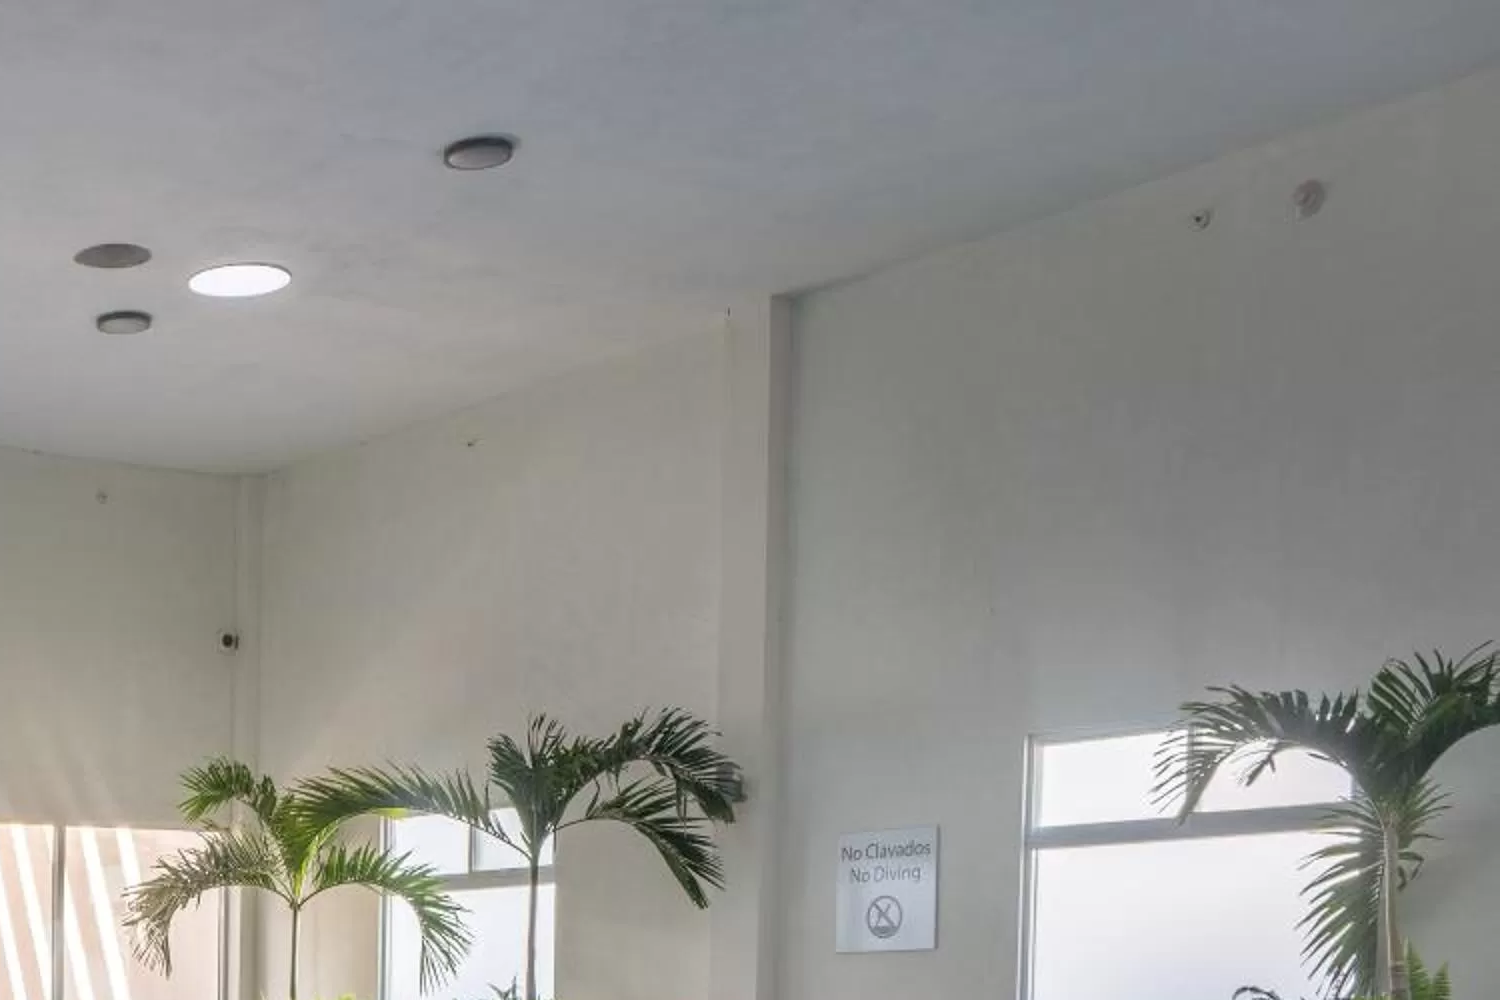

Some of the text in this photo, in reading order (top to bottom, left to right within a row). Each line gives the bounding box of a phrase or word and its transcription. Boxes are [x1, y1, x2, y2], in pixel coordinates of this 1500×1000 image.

[841, 840, 931, 862] No Clavados
[850, 865, 921, 883] No Diving
